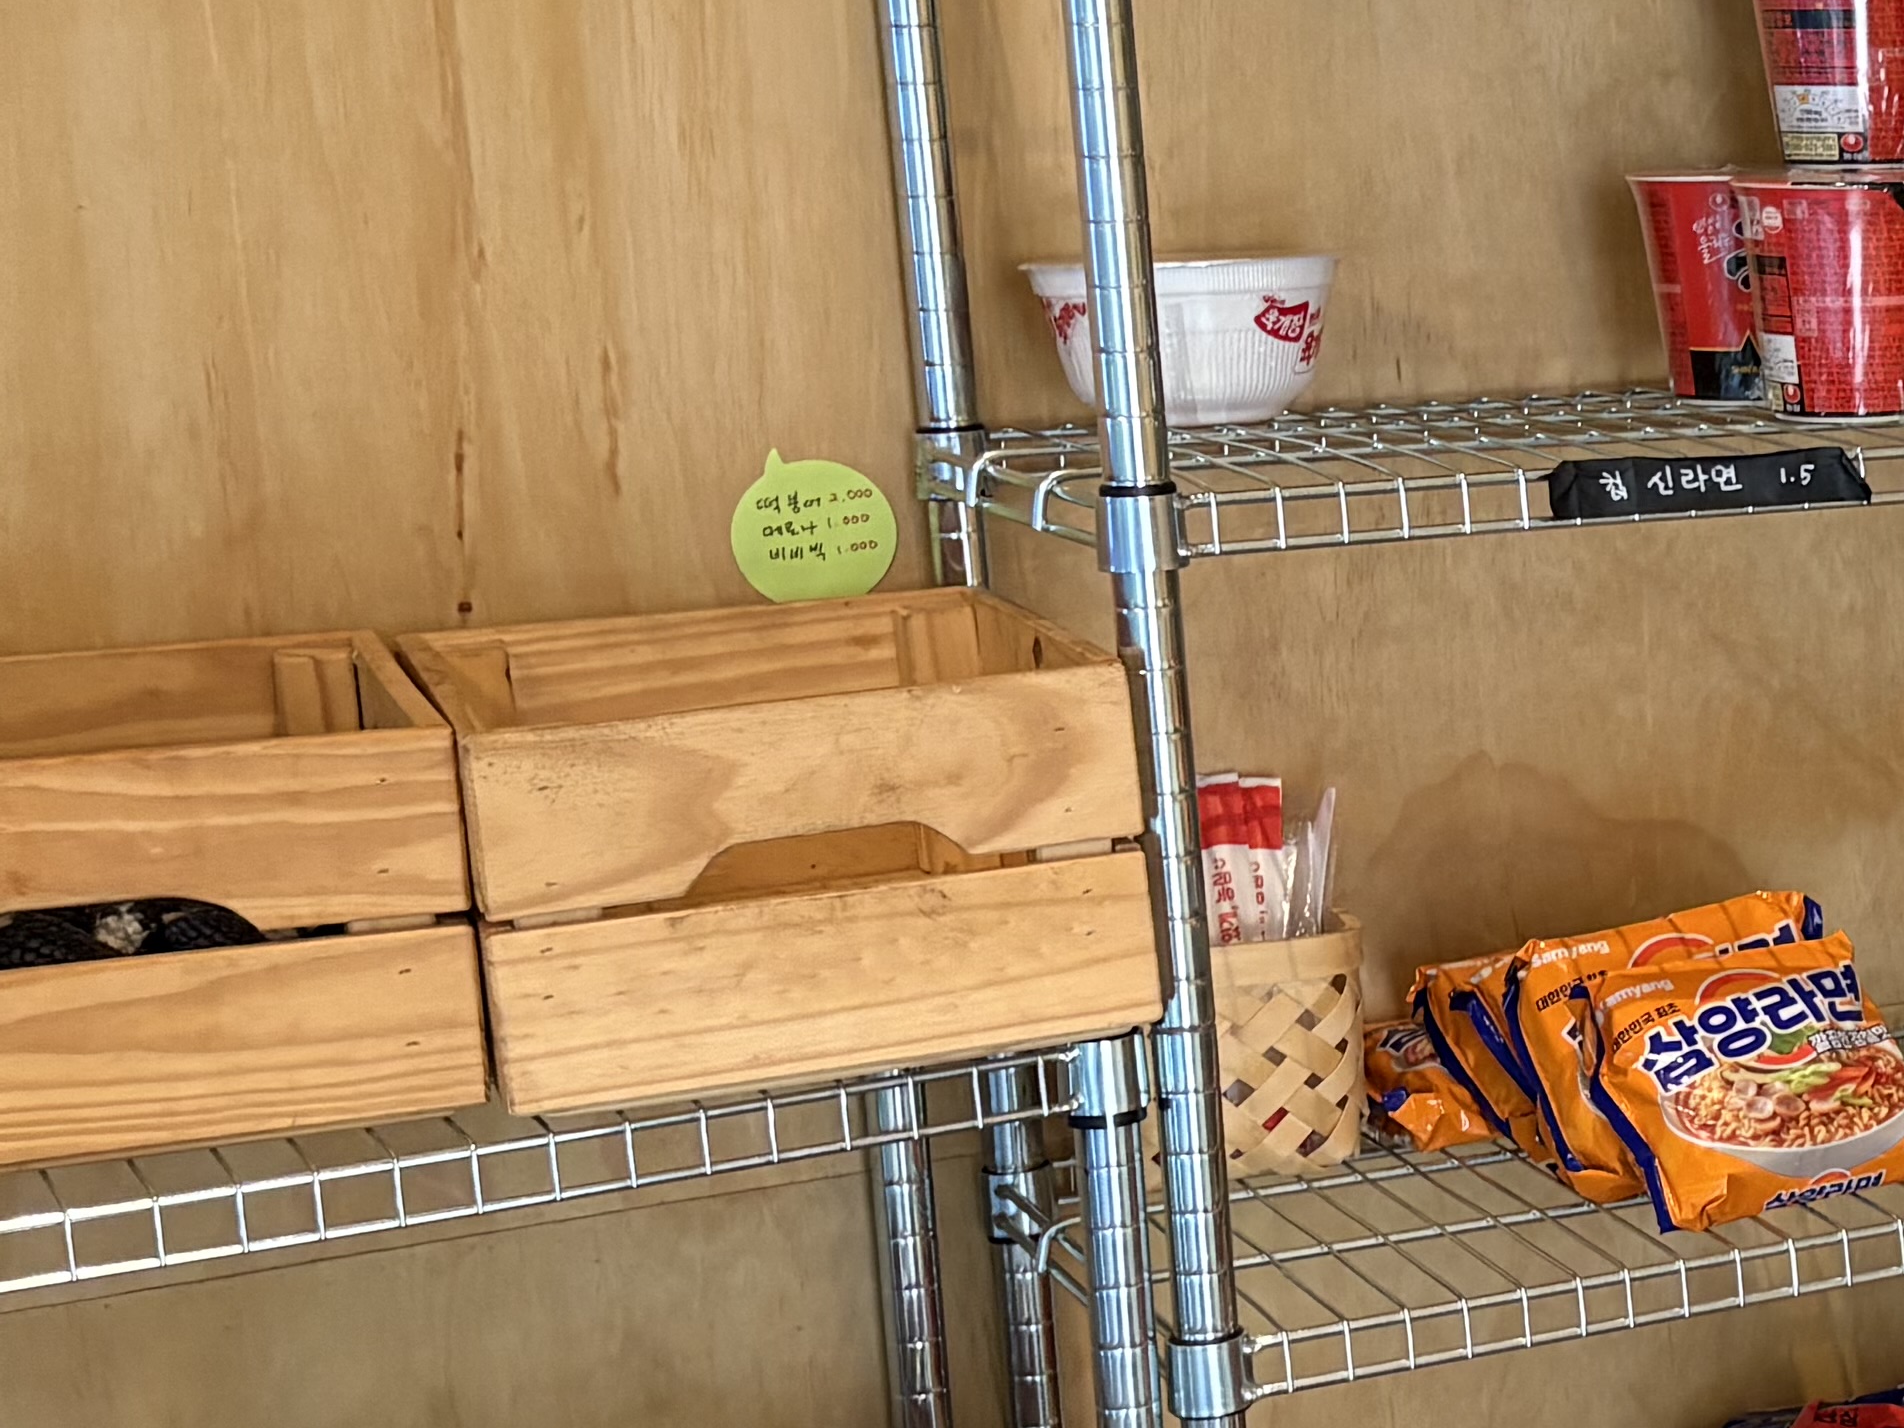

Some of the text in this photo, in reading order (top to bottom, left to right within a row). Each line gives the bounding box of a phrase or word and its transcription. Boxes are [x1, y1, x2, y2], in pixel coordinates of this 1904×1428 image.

[1600, 470, 1628, 502] 컵
[1780, 464, 1815, 486] 1.5
[1640, 960, 1865, 1094] 삼양라면
